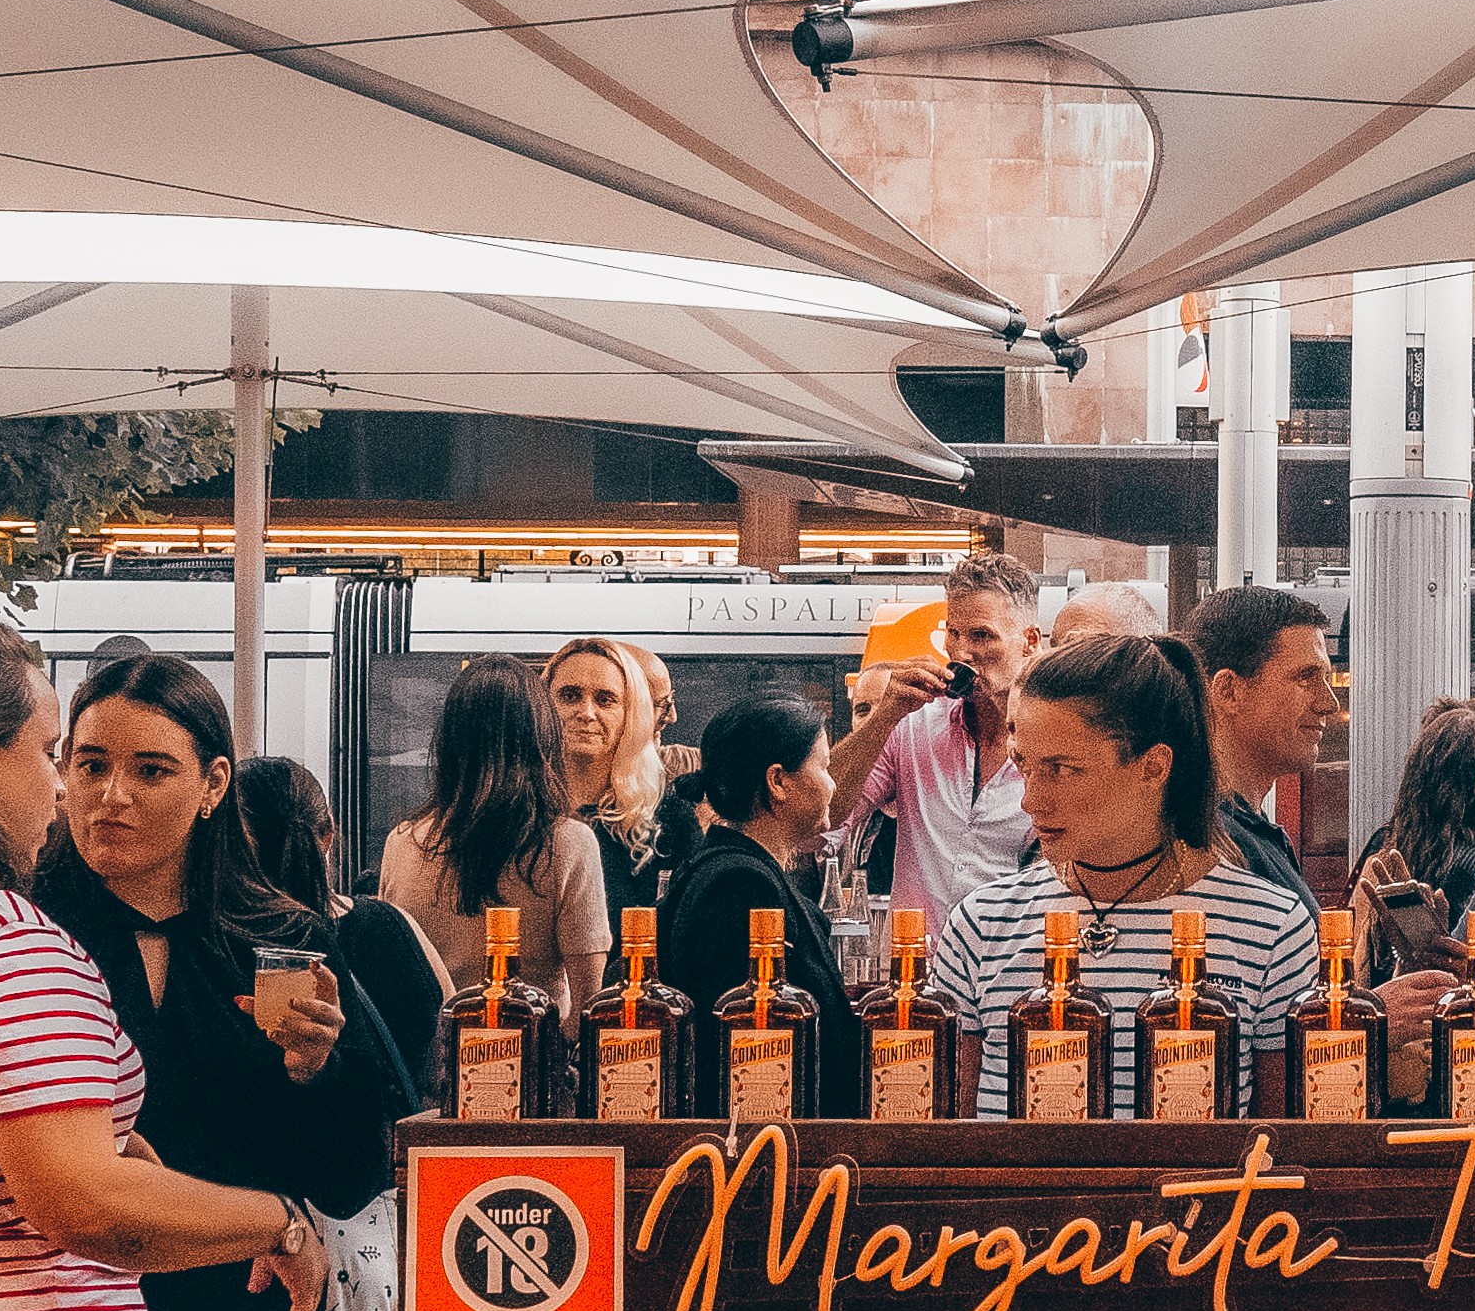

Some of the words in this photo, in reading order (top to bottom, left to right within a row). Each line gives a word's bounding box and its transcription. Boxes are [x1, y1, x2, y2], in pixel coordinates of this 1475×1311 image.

[686, 597, 875, 622] PASPALE
[461, 1036, 520, 1065] COINTREAU
[600, 1037, 659, 1065] COINTREAU
[732, 1037, 791, 1065] COINTREAU
[872, 1038, 932, 1066] COINTREAU
[1028, 1039, 1086, 1067] COINTREAU
[1155, 1039, 1213, 1067] COINTREAU
[1306, 1038, 1364, 1067] COINTREAU
[487, 1202, 553, 1225] under
[476, 1226, 549, 1294] 18
